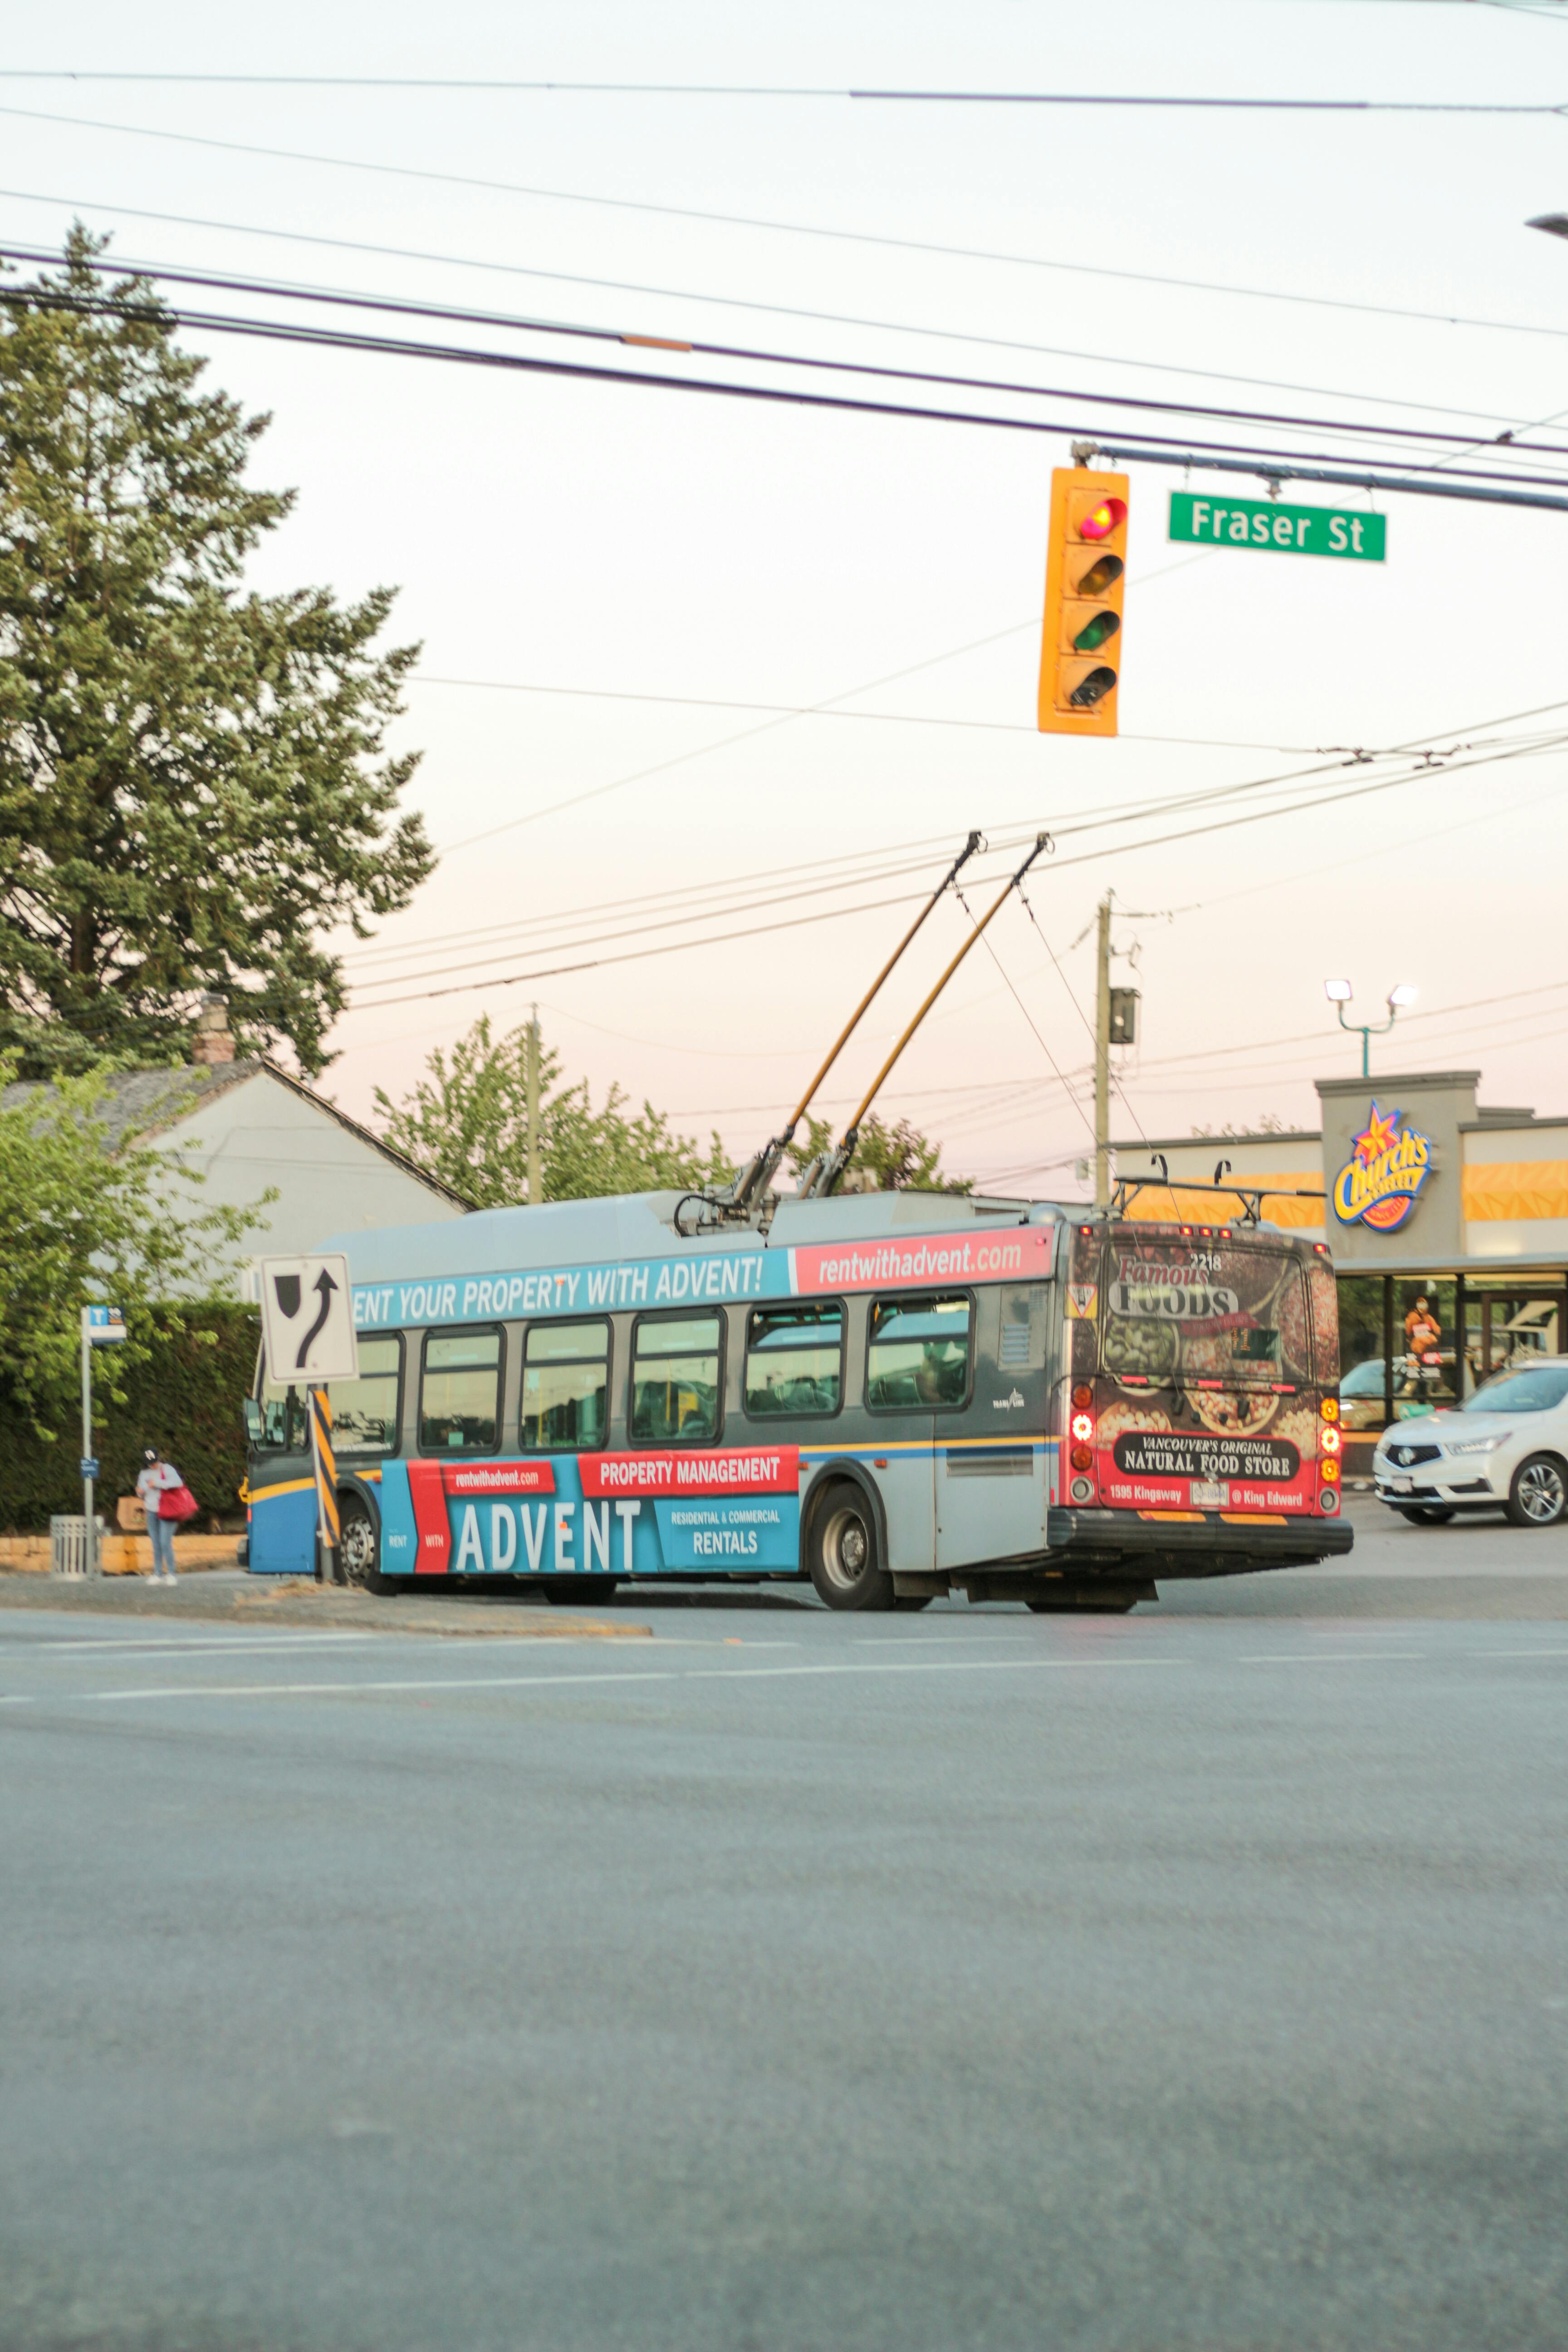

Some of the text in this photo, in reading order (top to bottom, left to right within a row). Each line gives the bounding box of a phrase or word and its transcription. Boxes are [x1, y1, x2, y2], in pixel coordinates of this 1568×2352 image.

[1192, 500, 1364, 553] Fraser St
[819, 1241, 1022, 1284] rentwithadvent.com
[1119, 1255, 1210, 1286] Famous
[1191, 1253, 1222, 1271] 2218
[353, 1256, 763, 1323] ENT YOUR PROPERTY WITH ADVENT!
[1143, 1436, 1273, 1455] VANCOUVER'S ORIGINAL
[600, 1456, 780, 1486] PROPERTY MANAGEMENT
[1125, 1450, 1290, 1476] NATURAL FOOD STORE
[456, 1470, 539, 1488] rentwithadvent.com
[1134, 1485, 1181, 1504] Kingsway
[1244, 1490, 1265, 1508] King
[1267, 1491, 1303, 1507] Edward
[671, 1511, 720, 1525] RESIDENTIAL
[729, 1509, 781, 1524] COMMERCIAL
[456, 1500, 642, 1571] ADVENT
[693, 1530, 758, 1555] RENTALS
